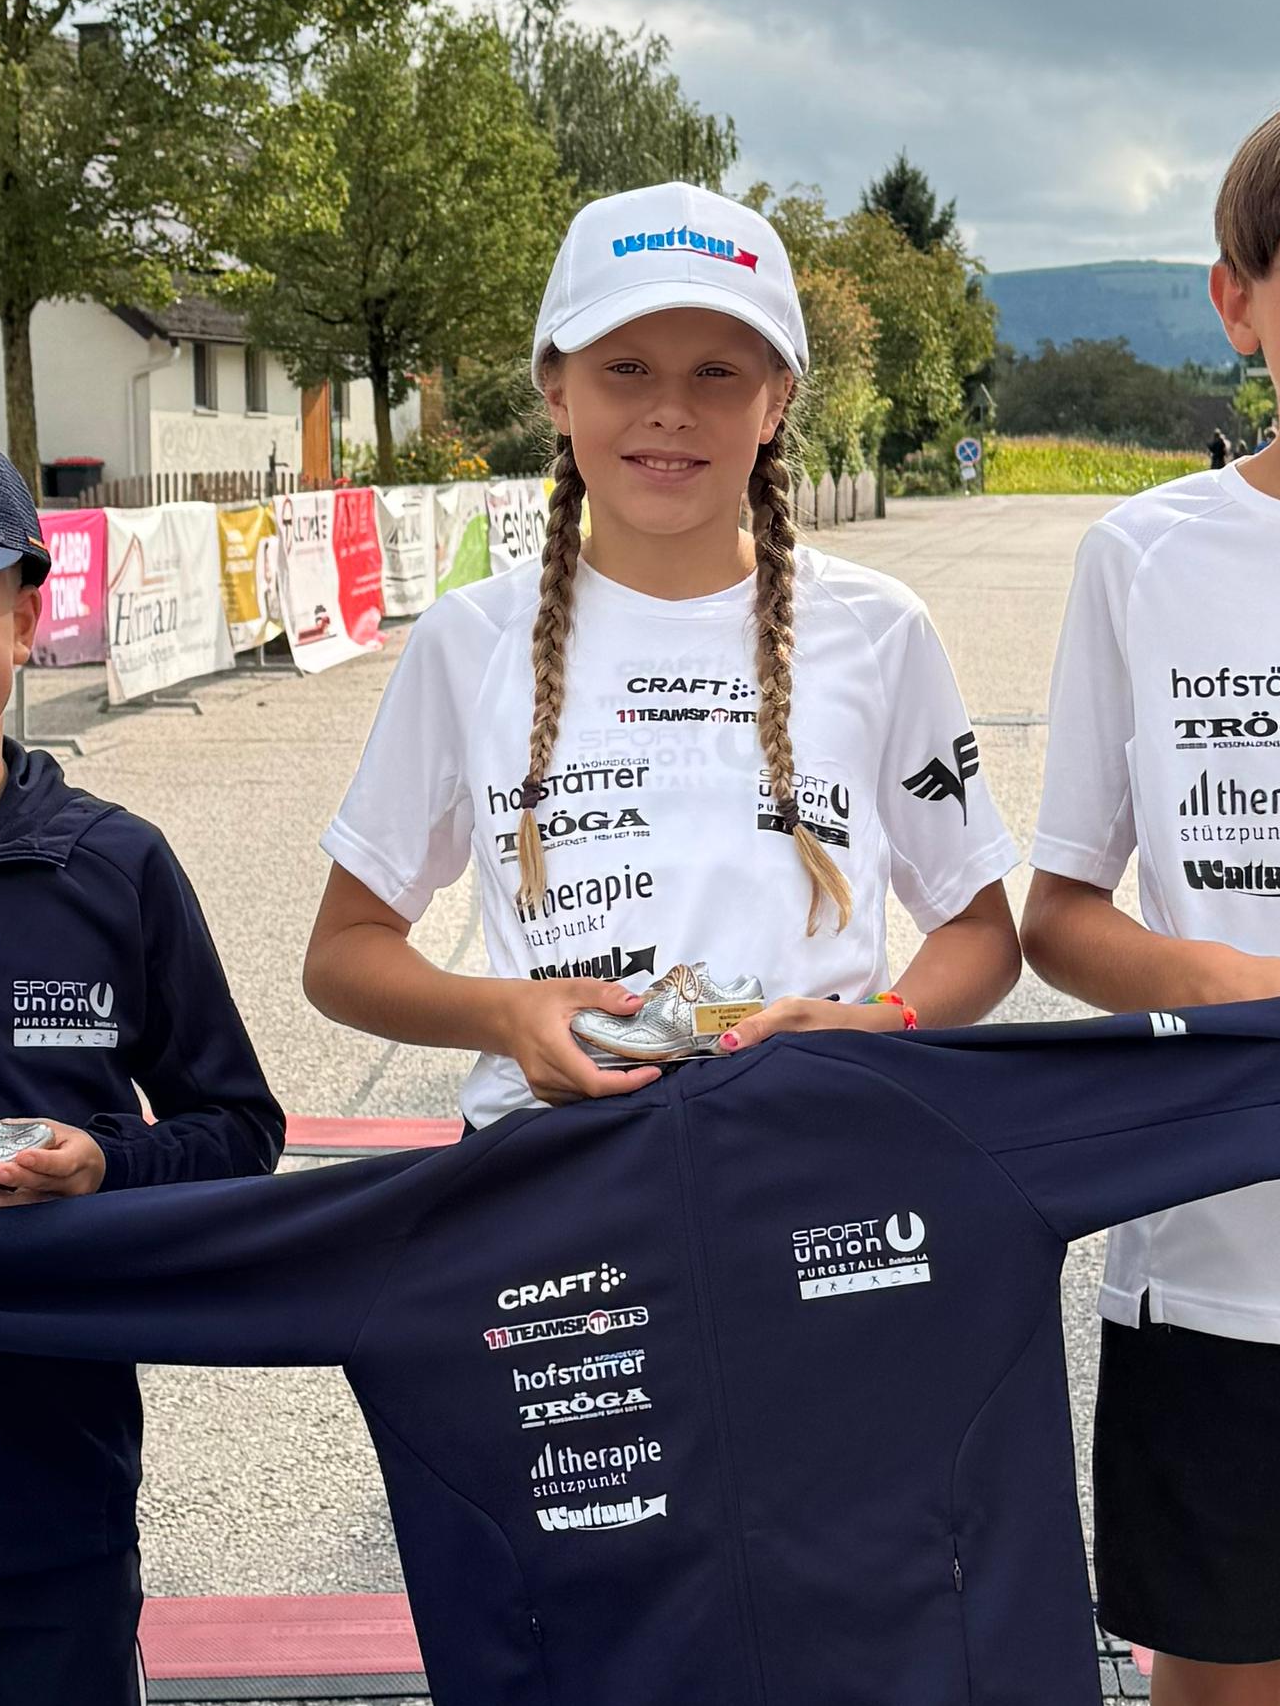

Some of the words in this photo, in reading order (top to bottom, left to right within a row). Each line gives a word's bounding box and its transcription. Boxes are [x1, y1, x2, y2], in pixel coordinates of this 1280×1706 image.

[50, 532, 91, 574] CARBO
[626, 677, 728, 696] CRAFT
[487, 762, 650, 815] hostätter
[759, 769, 829, 792] SORT
[759, 784, 829, 809] uion
[757, 803, 826, 824] PUTALL
[543, 864, 654, 919] herapie
[13, 980, 88, 997] SPORT
[13, 996, 89, 1012] union
[13, 1016, 91, 1028] PURGSTALL
[792, 1219, 879, 1247] SPORT
[794, 1237, 882, 1263] union
[797, 1258, 885, 1280] PURGSTALL
[497, 1270, 597, 1310] CRAFT
[483, 1305, 649, 1350] 11TEAMSPORTS
[512, 1355, 646, 1392] hofstätter
[519, 1387, 651, 1421] TRÖGA
[557, 1436, 662, 1474] therapie
[533, 1472, 628, 1499] stützpunkt
